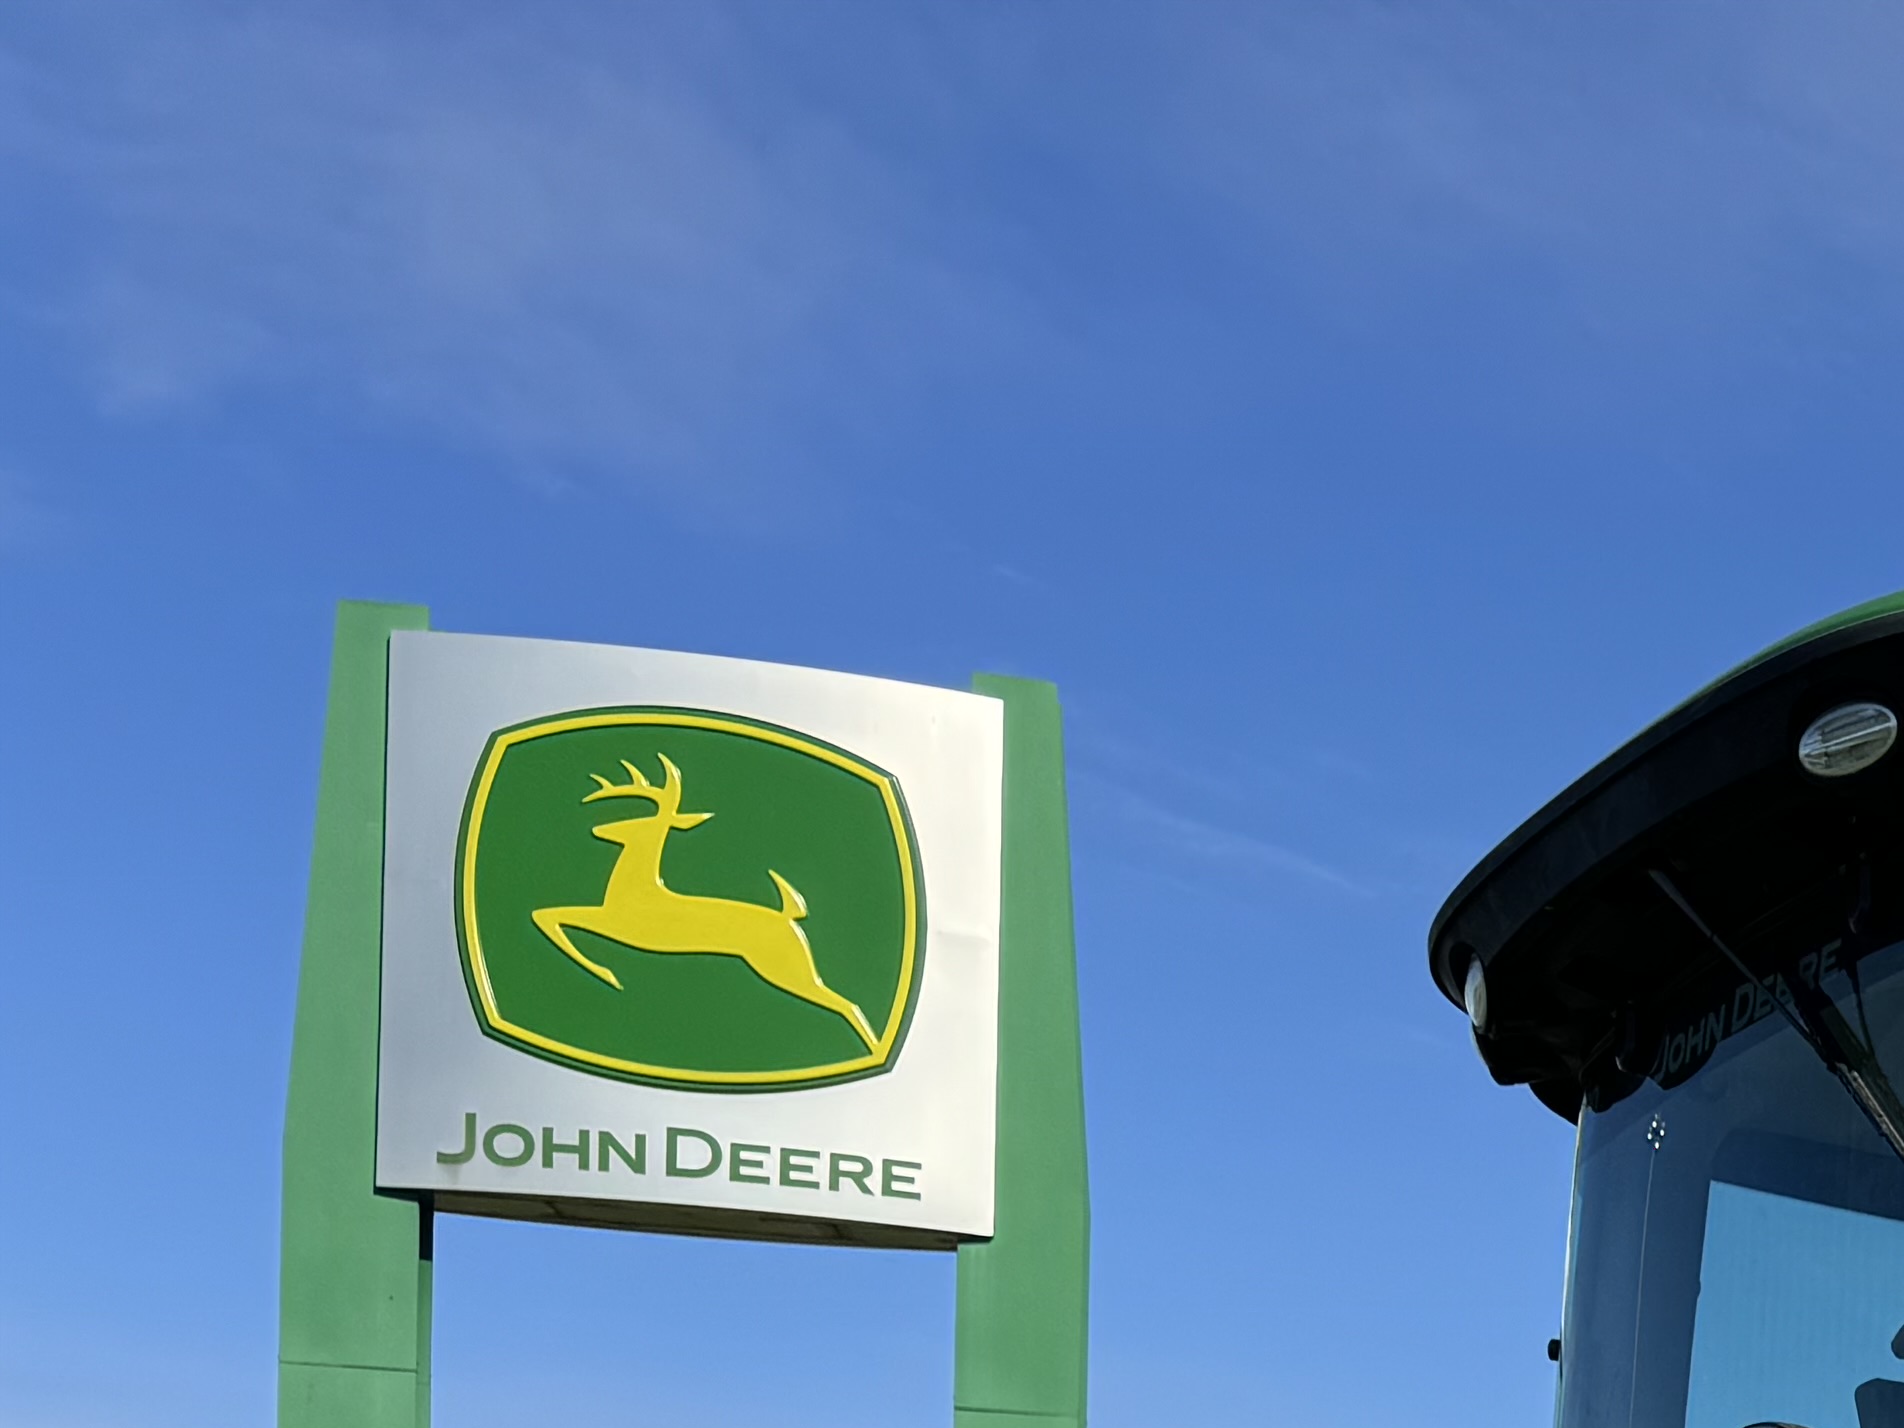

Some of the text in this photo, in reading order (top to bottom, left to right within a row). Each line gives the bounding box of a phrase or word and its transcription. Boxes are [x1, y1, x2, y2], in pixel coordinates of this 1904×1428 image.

[1654, 1003, 1727, 1084] JOHN
[436, 1112, 922, 1201] JOHN DEERE
